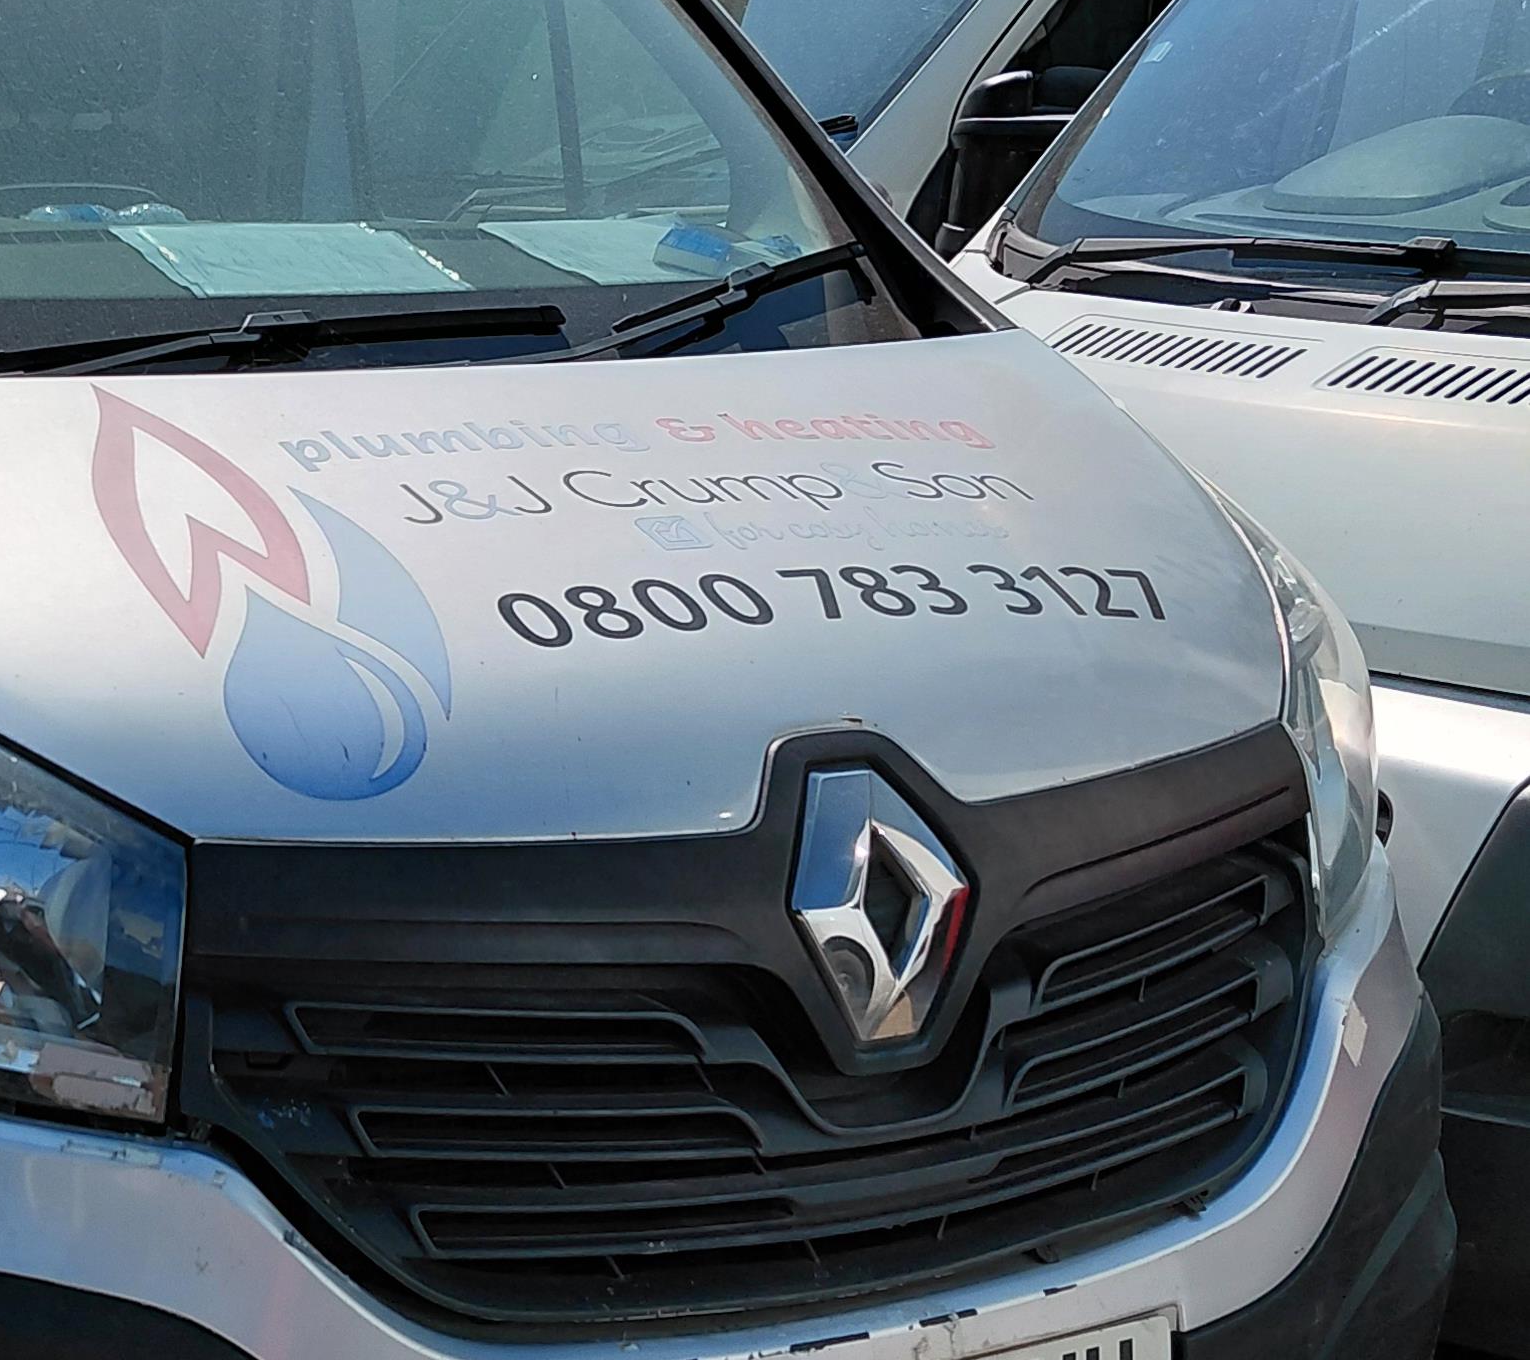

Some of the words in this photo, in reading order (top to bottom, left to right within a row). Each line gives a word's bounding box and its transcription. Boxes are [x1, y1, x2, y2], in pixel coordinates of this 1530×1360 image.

[278, 417, 650, 472] plumbing
[654, 415, 716, 444] &
[717, 411, 997, 449] heating
[400, 474, 556, 526] J&J
[497, 573, 775, 649] 0800
[775, 564, 968, 620] 783
[967, 562, 1168, 621] 3127
